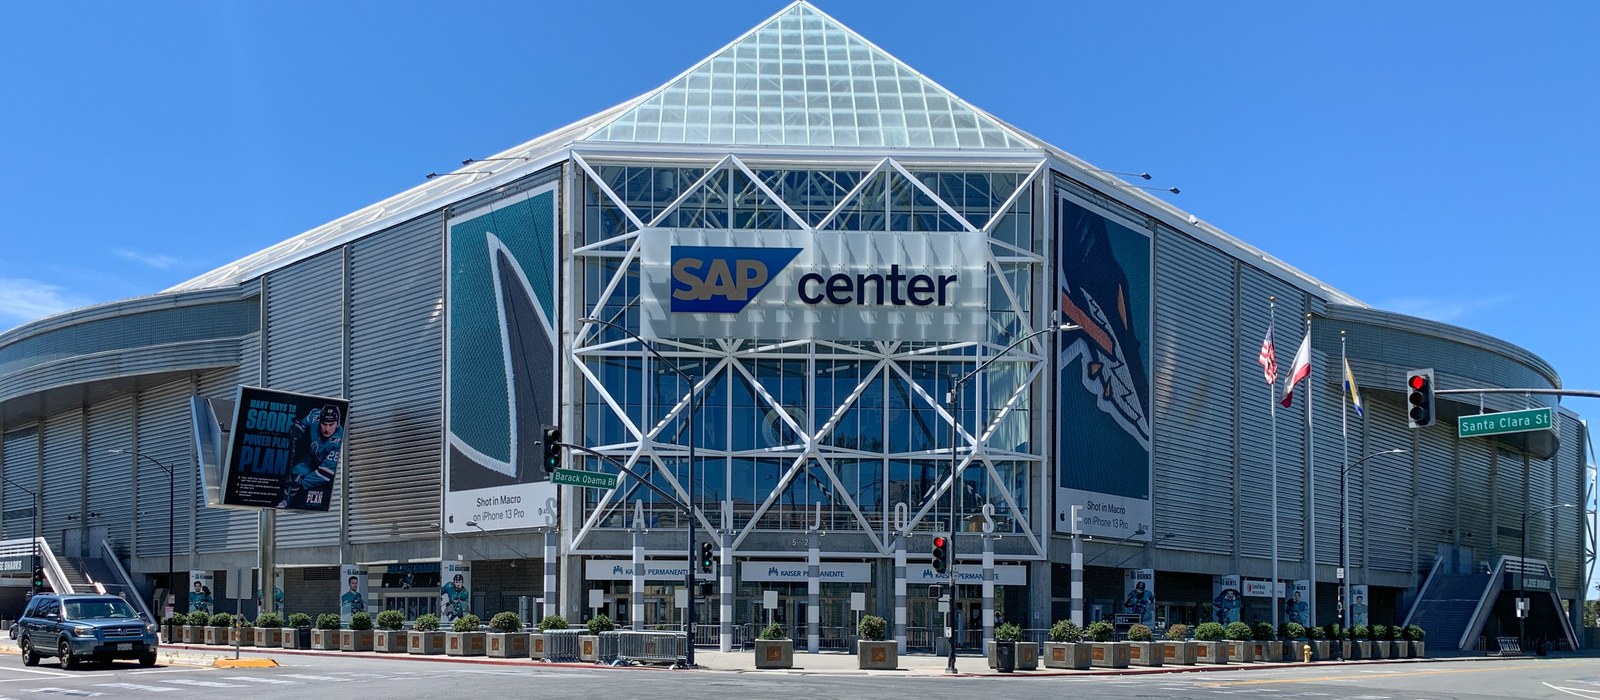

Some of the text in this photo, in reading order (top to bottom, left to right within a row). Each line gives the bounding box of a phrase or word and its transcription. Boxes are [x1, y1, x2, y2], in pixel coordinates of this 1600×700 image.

[672, 258, 957, 306] SAP center
[250, 400, 297, 413] MANY WAYS TO
[1462, 413, 1549, 431] Santa Clara St
[243, 433, 271, 446] POWER
[239, 445, 290, 475] PLAN
[555, 472, 580, 483] Barack
[582, 475, 606, 484] Obama
[306, 493, 323, 504] PLAN
[476, 495, 521, 507] Shot in Macro
[1087, 500, 1125, 515] Shot in Macro
[481, 511, 503, 521] iPhone
[505, 509, 512, 519] 13
[513, 509, 525, 518] Pro
[1083, 516, 1128, 529] on iPhone 13 Pro
